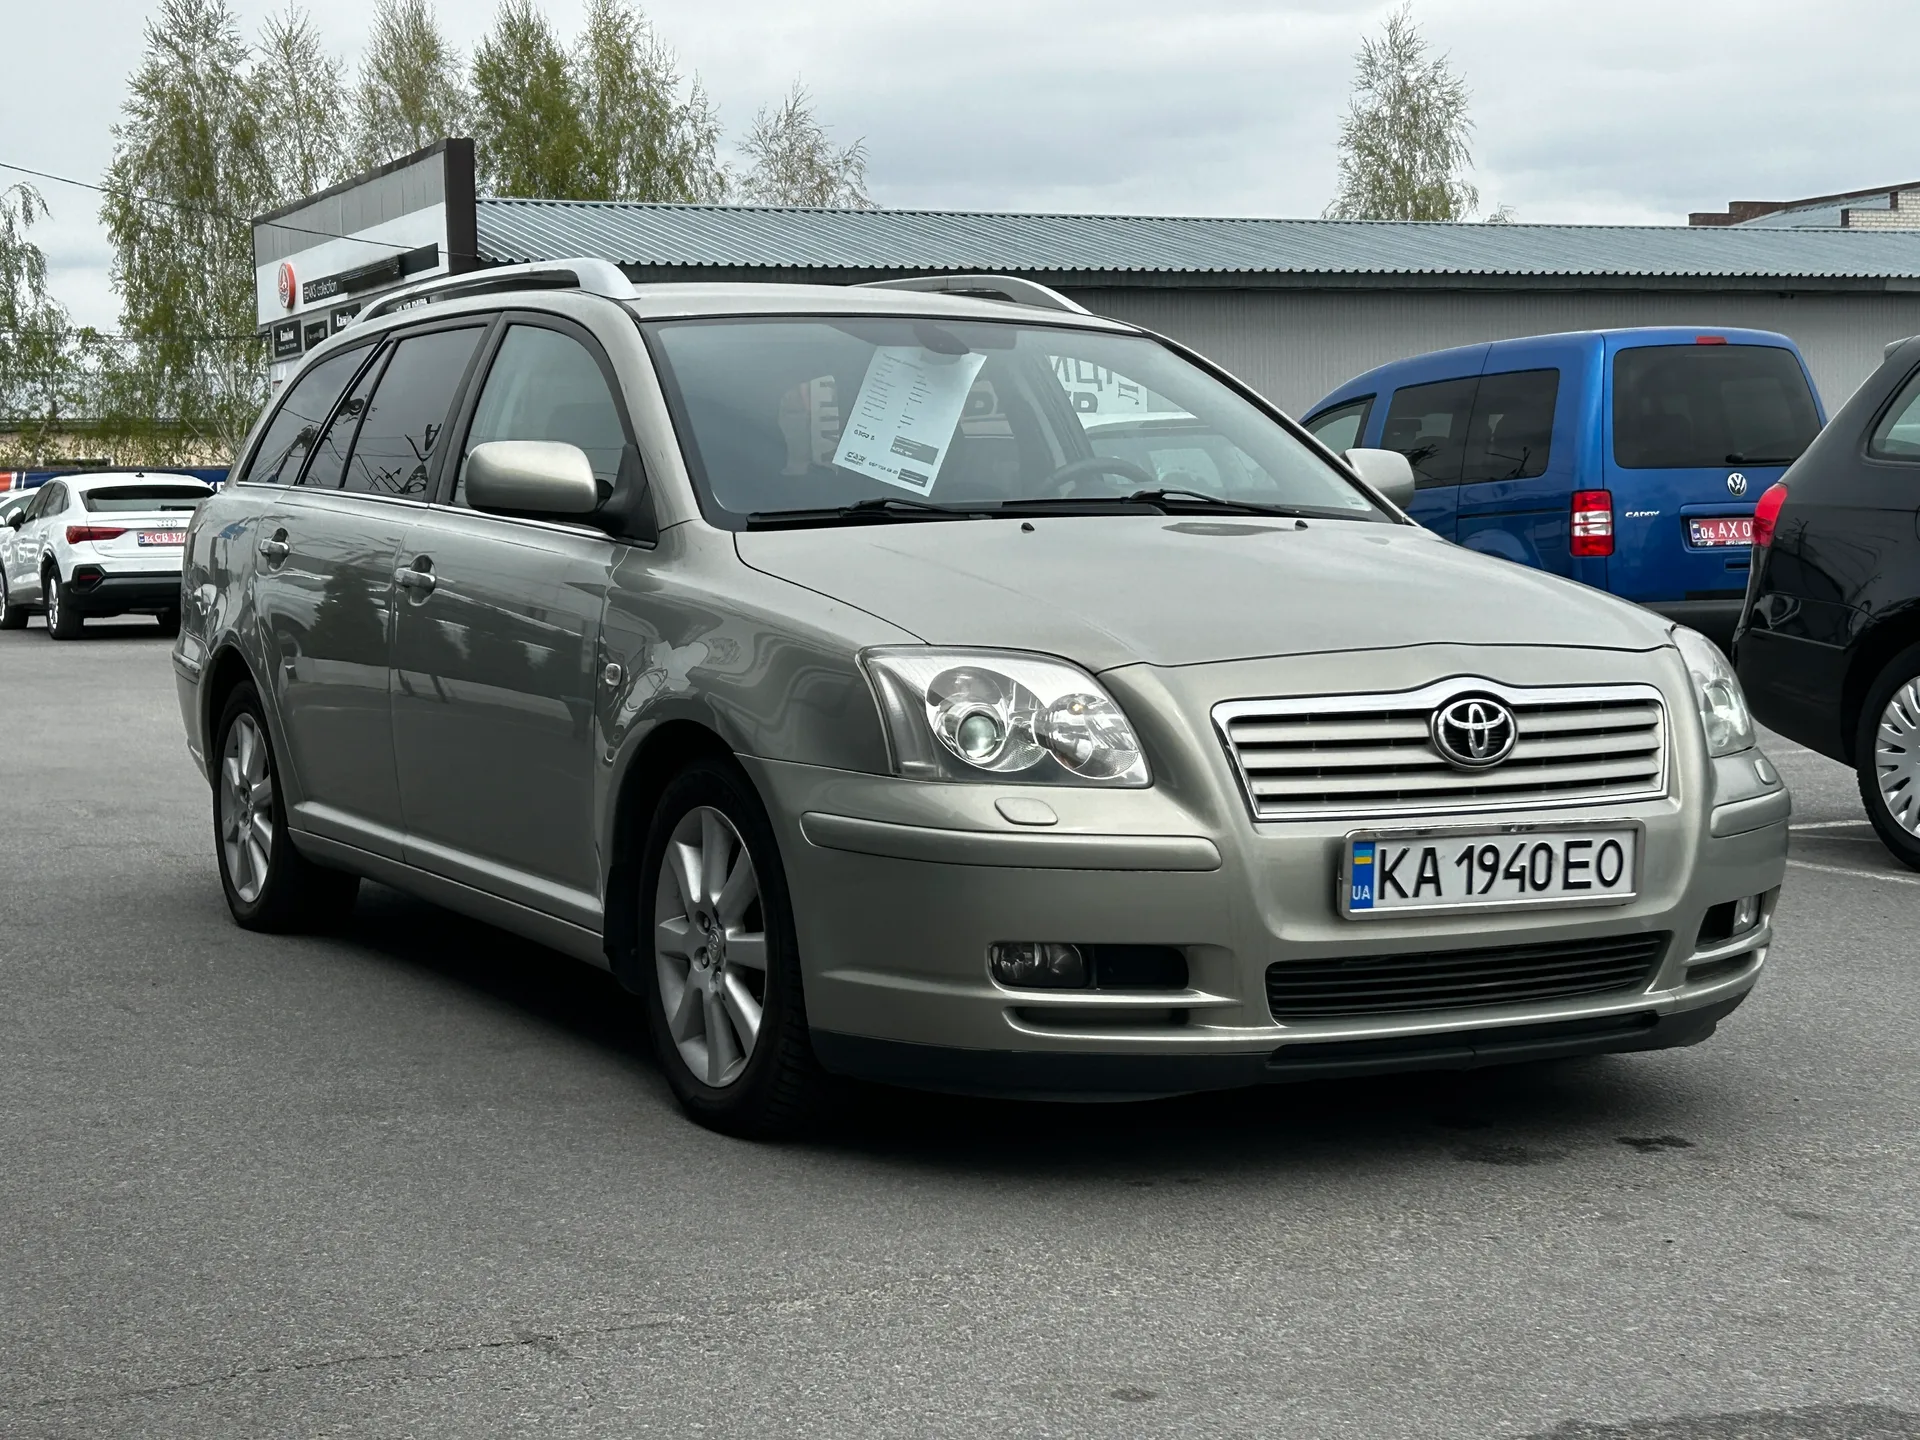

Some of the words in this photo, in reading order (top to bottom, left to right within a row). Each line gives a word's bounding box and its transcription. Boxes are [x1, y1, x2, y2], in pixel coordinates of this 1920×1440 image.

[1718, 521, 1740, 538] AX
[1378, 846, 1443, 900] KA
[1454, 841, 1553, 896] 1940
[1562, 838, 1624, 890] EO
[1352, 885, 1371, 901] UA
